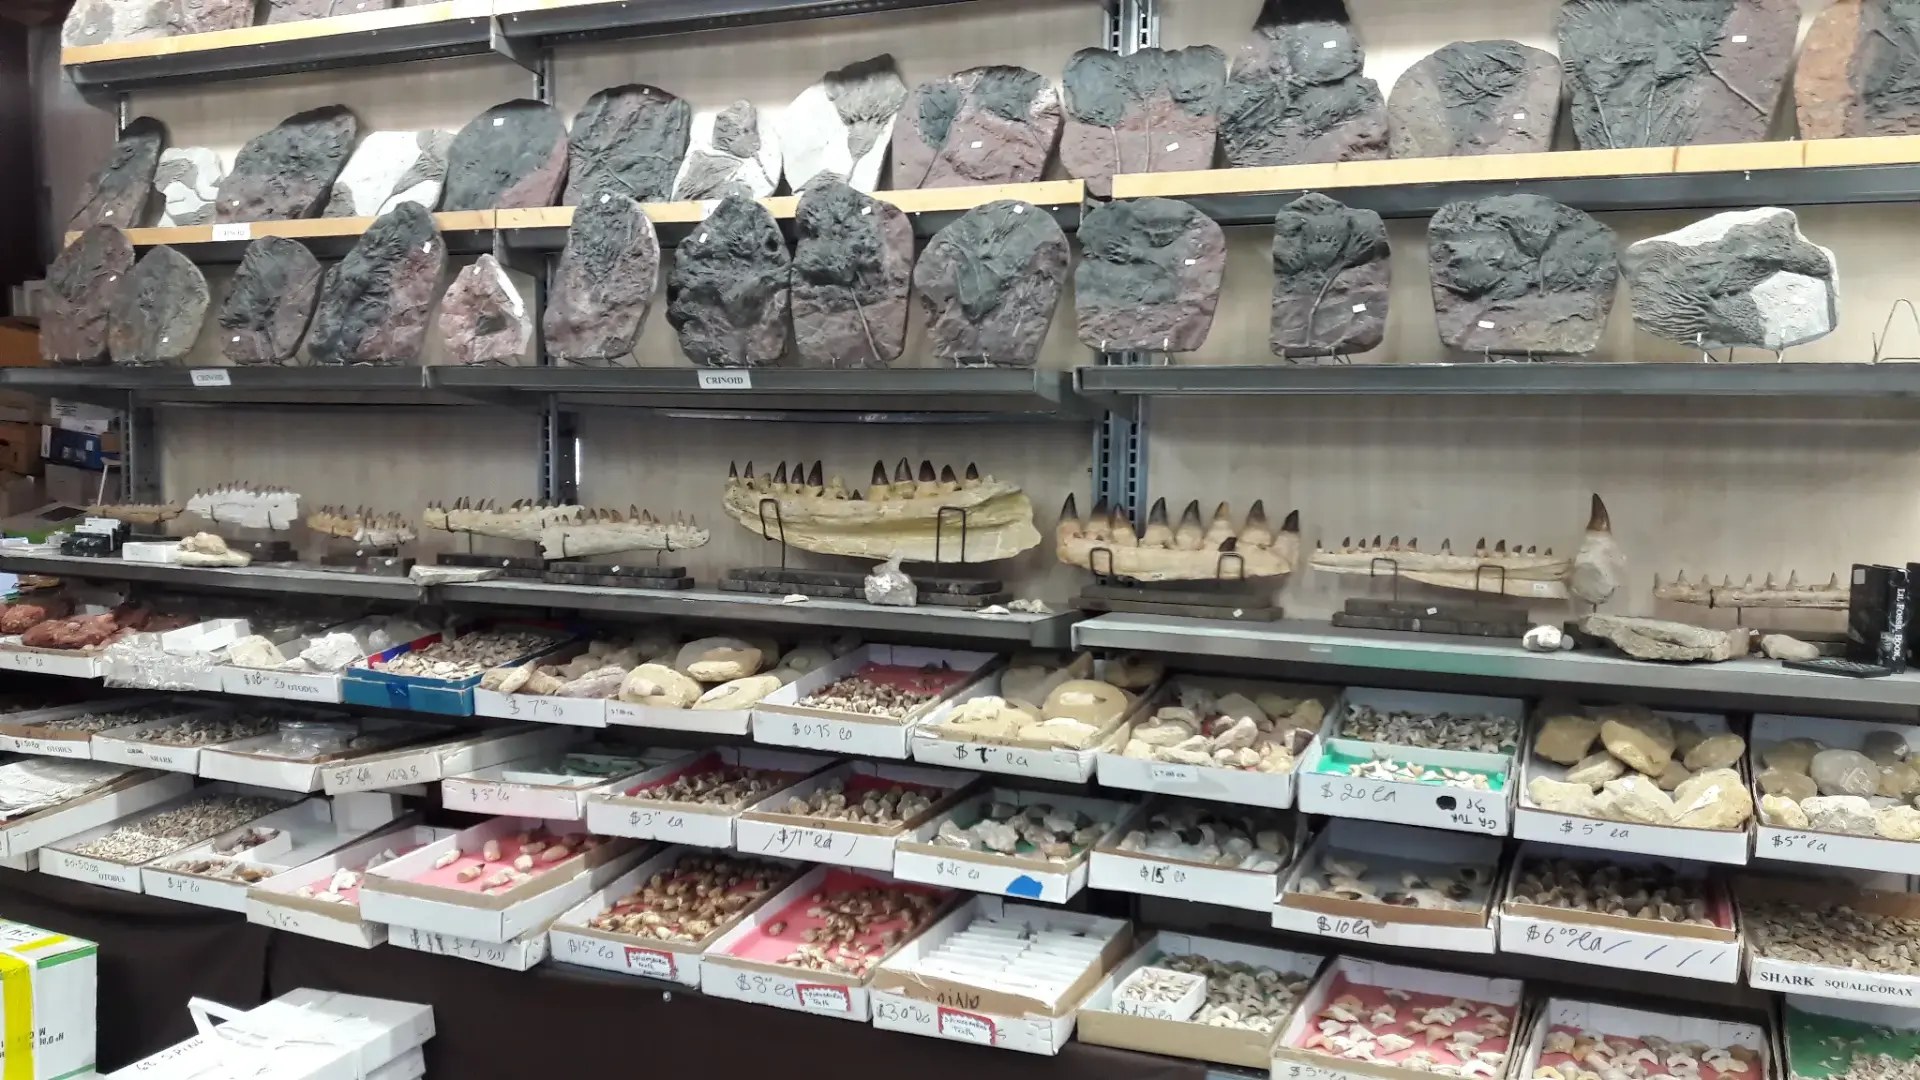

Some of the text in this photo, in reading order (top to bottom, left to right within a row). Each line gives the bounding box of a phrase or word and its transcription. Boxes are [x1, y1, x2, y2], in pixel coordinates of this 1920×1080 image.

[705, 376, 744, 385] CRINOID
[1759, 971, 1913, 998] SHARK SQUALICORAX
